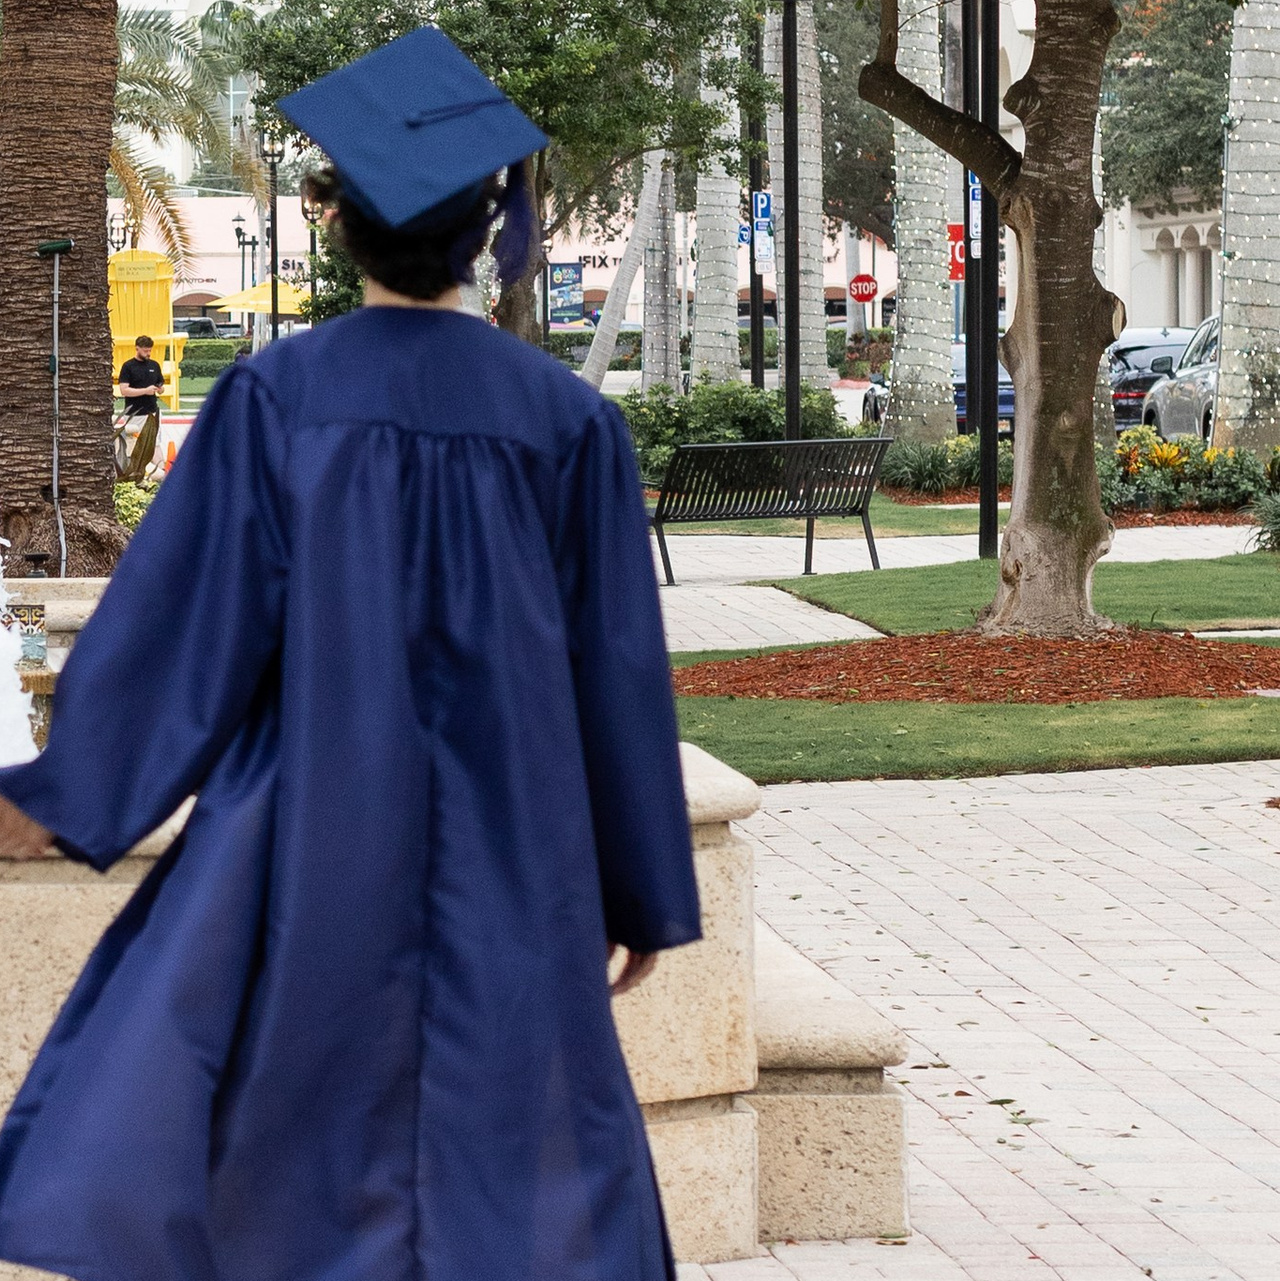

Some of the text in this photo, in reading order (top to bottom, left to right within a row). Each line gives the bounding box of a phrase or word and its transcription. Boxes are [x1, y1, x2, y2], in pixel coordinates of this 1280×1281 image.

[757, 194, 768, 218] P
[281, 258, 305, 270] Six
[850, 282, 877, 296] STOP
